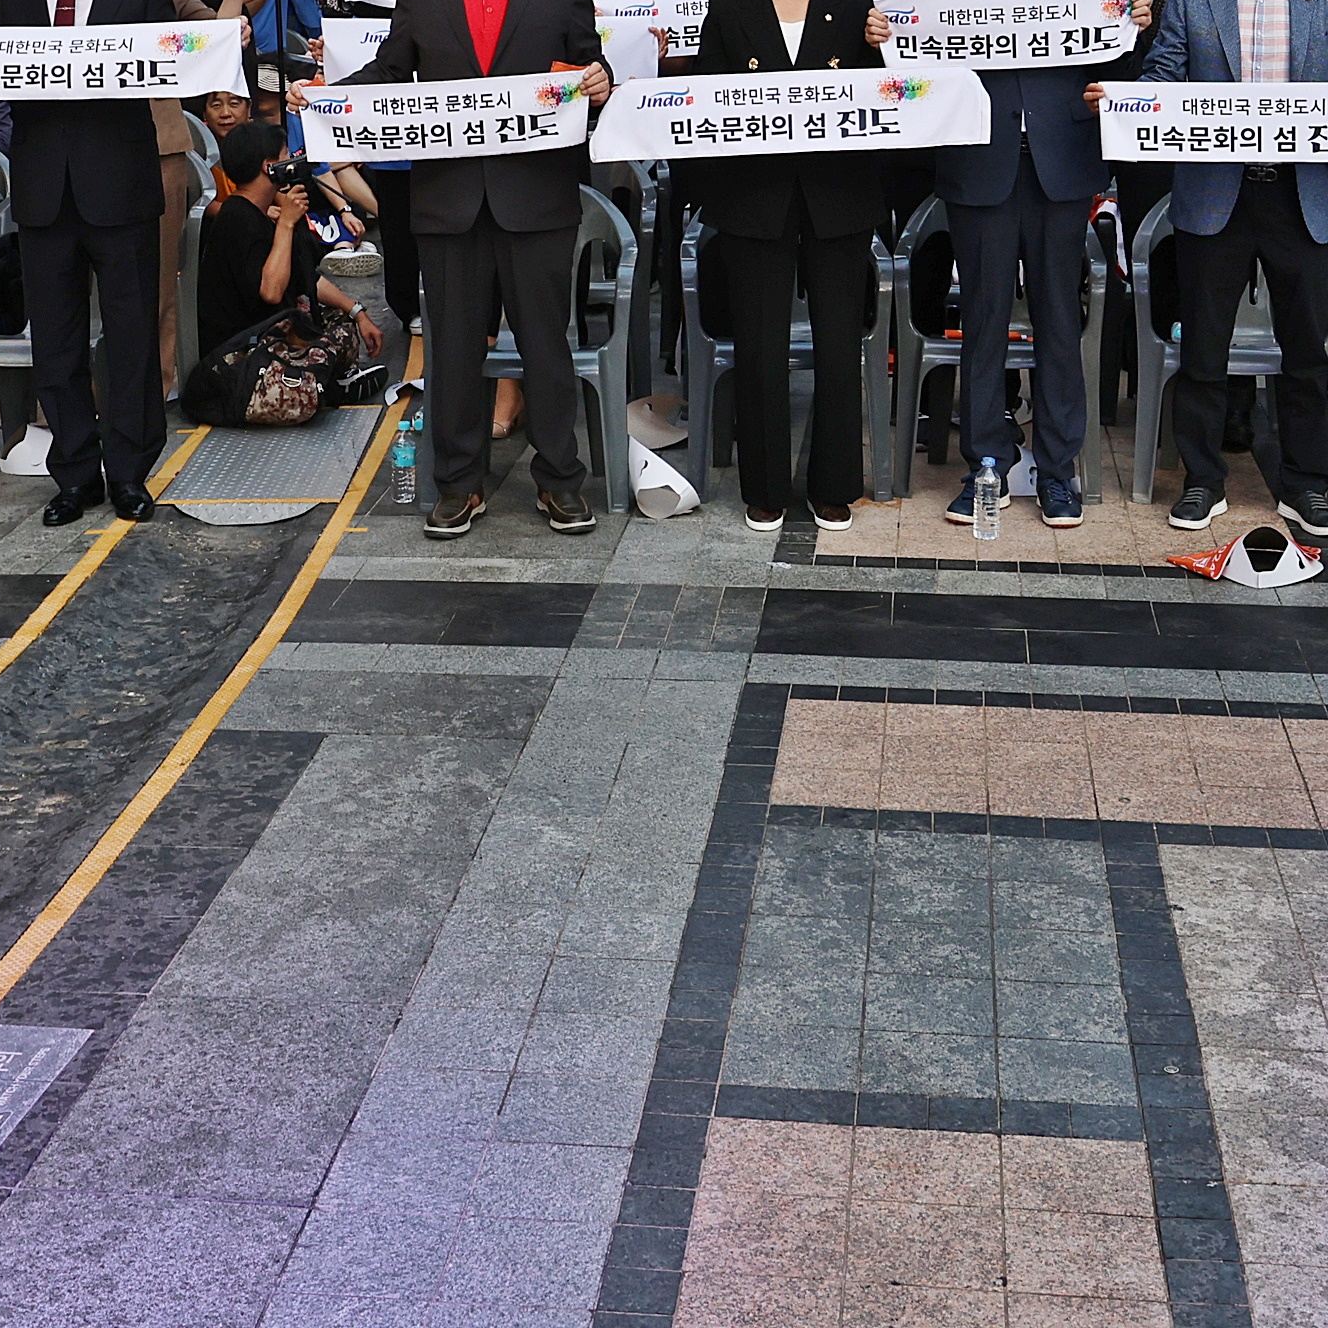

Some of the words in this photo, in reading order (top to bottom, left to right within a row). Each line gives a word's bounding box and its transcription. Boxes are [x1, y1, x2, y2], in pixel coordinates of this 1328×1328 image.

[939, 8, 1005, 26] 대한민국
[1011, 4, 1078, 24] 문화도시
[0, 39, 62, 55] 대한민국
[69, 38, 135, 54] 문화도시
[895, 34, 1018, 60] 민속문화의
[1027, 32, 1051, 58] 섬
[1059, 24, 1122, 57] 진도
[82, 63, 105, 89] 섬
[115, 59, 179, 87] 진도
[373, 96, 439, 116] 대한민국
[445, 90, 512, 112] 문화도시
[636, 86, 689, 110] Jindo
[714, 87, 781, 107] 대한민국
[787, 83, 854, 103] 문화도시
[1105, 92, 1157, 113] Jindo
[1182, 98, 1250, 115] 대한민국
[1257, 98, 1327, 115] 문화도시
[332, 122, 452, 149] 민속문화의
[463, 122, 486, 145] 섬
[495, 111, 560, 142] 진도
[670, 113, 794, 145] 민속문화의
[803, 114, 826, 138] 섬
[836, 108, 901, 137] 진도
[1136, 126, 1263, 152] 민속문화의
[1273, 126, 1298, 152] 섬
